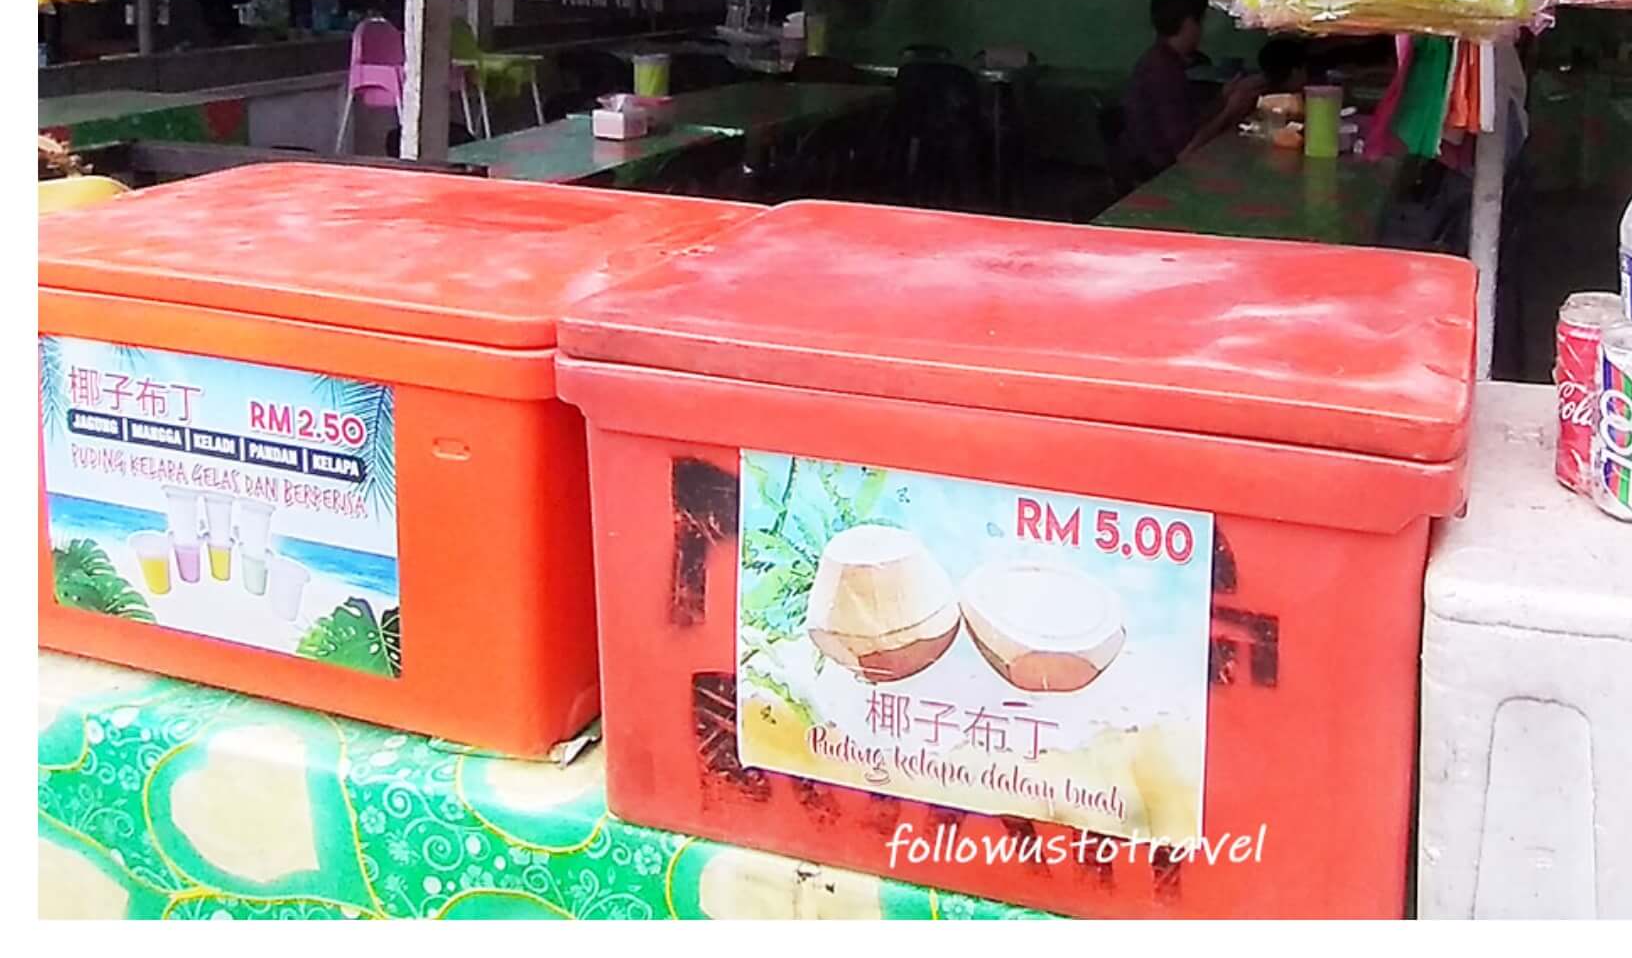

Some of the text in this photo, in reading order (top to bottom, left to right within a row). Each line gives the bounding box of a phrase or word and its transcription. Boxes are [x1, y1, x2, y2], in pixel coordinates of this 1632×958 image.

[68, 365, 202, 423] 椰子布丁
[250, 400, 365, 445] RM 2.50
[71, 443, 126, 475] PUDING
[130, 453, 190, 485] KELAPA
[191, 463, 240, 494] GELAS
[244, 474, 277, 503] DAN
[192, 433, 237, 455] KELADI
[250, 443, 299, 466] PANDAN
[312, 454, 361, 477] KELAPA
[1017, 497, 1195, 563] RM 5.00
[864, 689, 1060, 761] 椰子布丁
[806, 725, 1127, 823] Puding kelapa dalam buah
